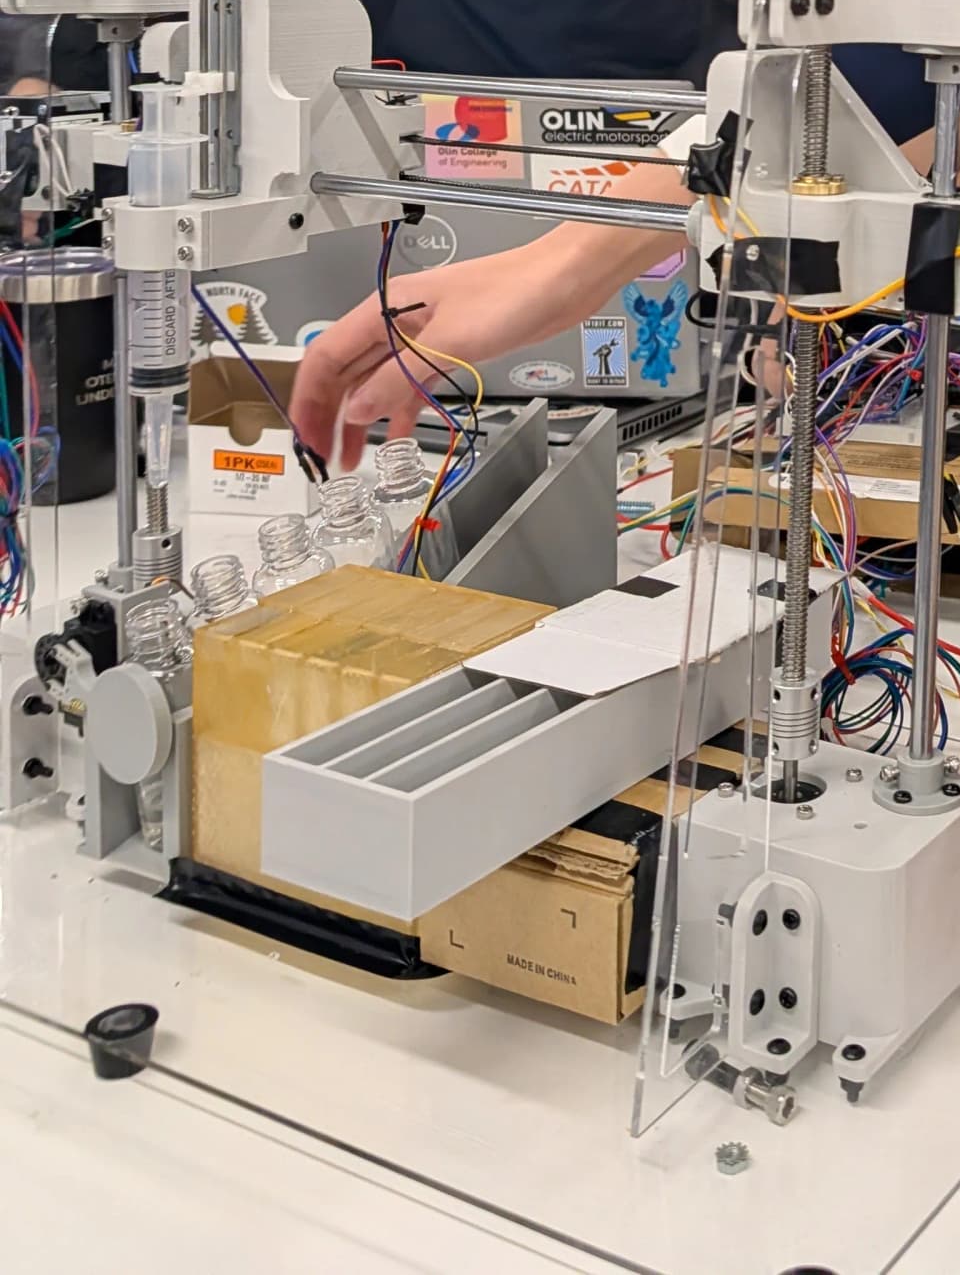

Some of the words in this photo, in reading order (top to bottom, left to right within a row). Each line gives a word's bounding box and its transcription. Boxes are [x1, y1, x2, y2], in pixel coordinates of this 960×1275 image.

[542, 111, 604, 130] OLIN
[545, 130, 592, 142] electric
[438, 147, 458, 156] Olin
[461, 147, 497, 157] College
[438, 158, 448, 166] of
[450, 158, 507, 169] Engineering
[404, 234, 450, 250] DELL
[165, 269, 176, 300] AFTE
[206, 286, 236, 298] NORTH
[239, 288, 261, 304] FACE
[165, 305, 176, 356] DISCARD
[224, 456, 255, 470] 1PK
[507, 953, 534, 972] MADE
[535, 964, 545, 976] IN
[547, 968, 576, 985] CHINA
